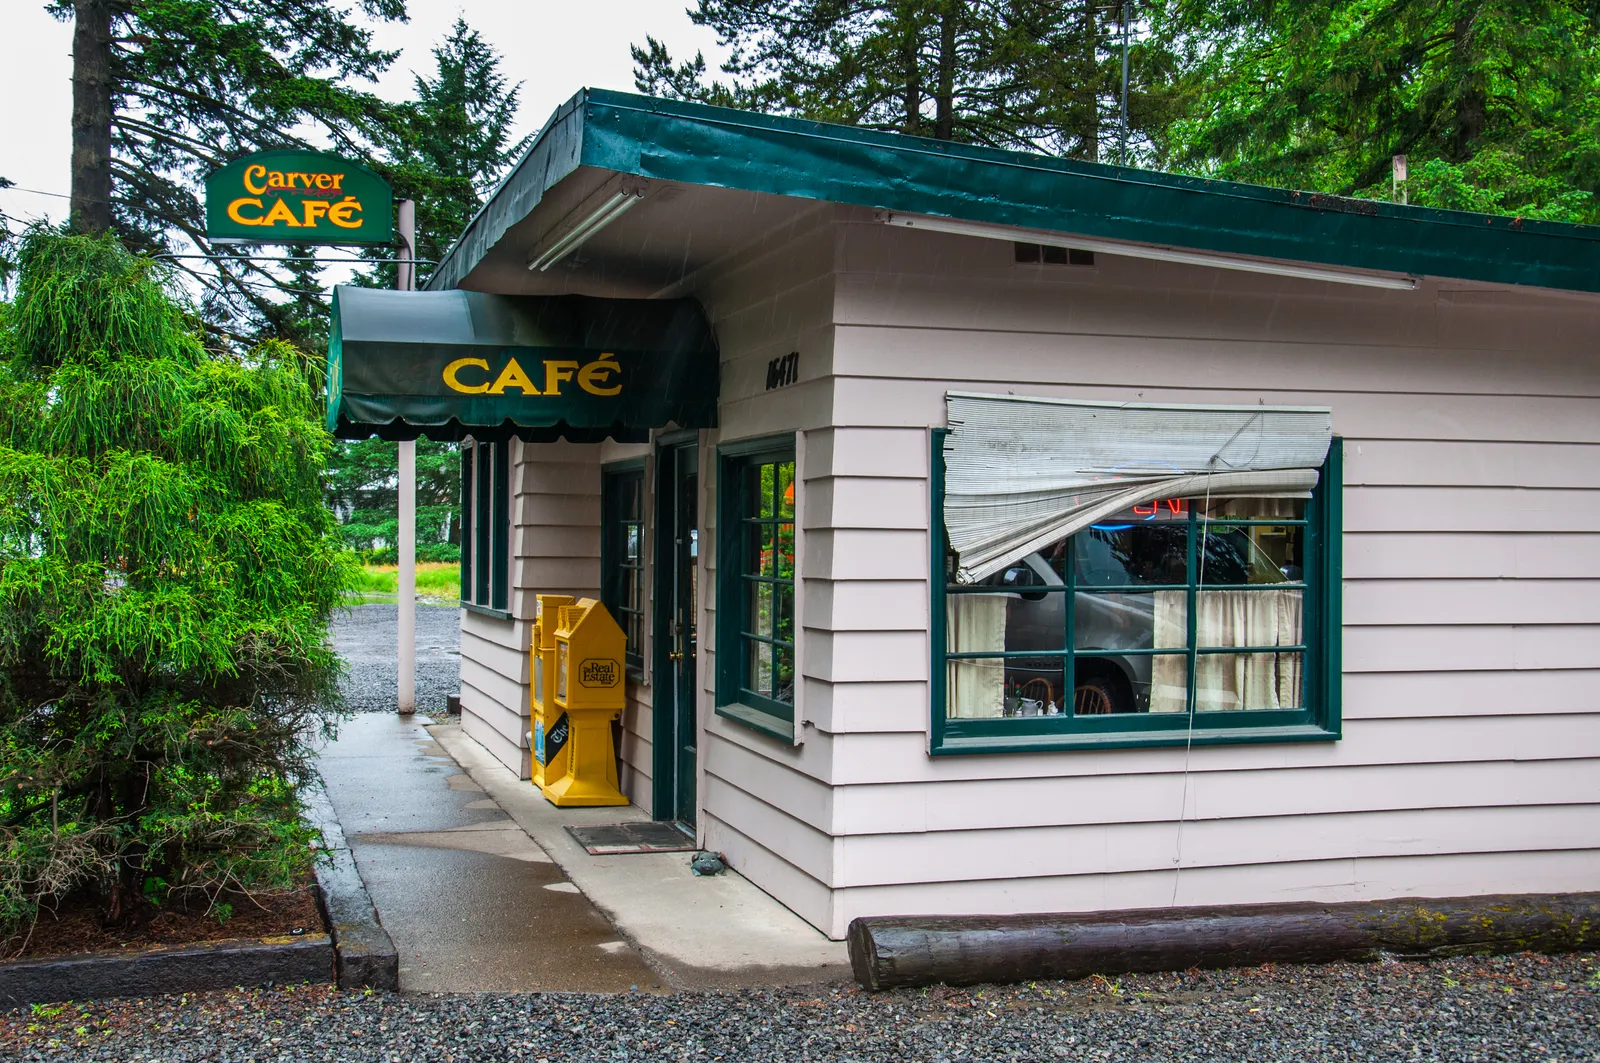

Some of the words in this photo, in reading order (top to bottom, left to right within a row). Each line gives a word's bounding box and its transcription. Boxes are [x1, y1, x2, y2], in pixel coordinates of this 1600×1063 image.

[243, 163, 345, 195] Carver
[227, 196, 364, 229] CAFÉ
[442, 353, 623, 396] CAFÉ
[583, 672, 615, 682] Estate
[591, 662, 614, 673] Real
